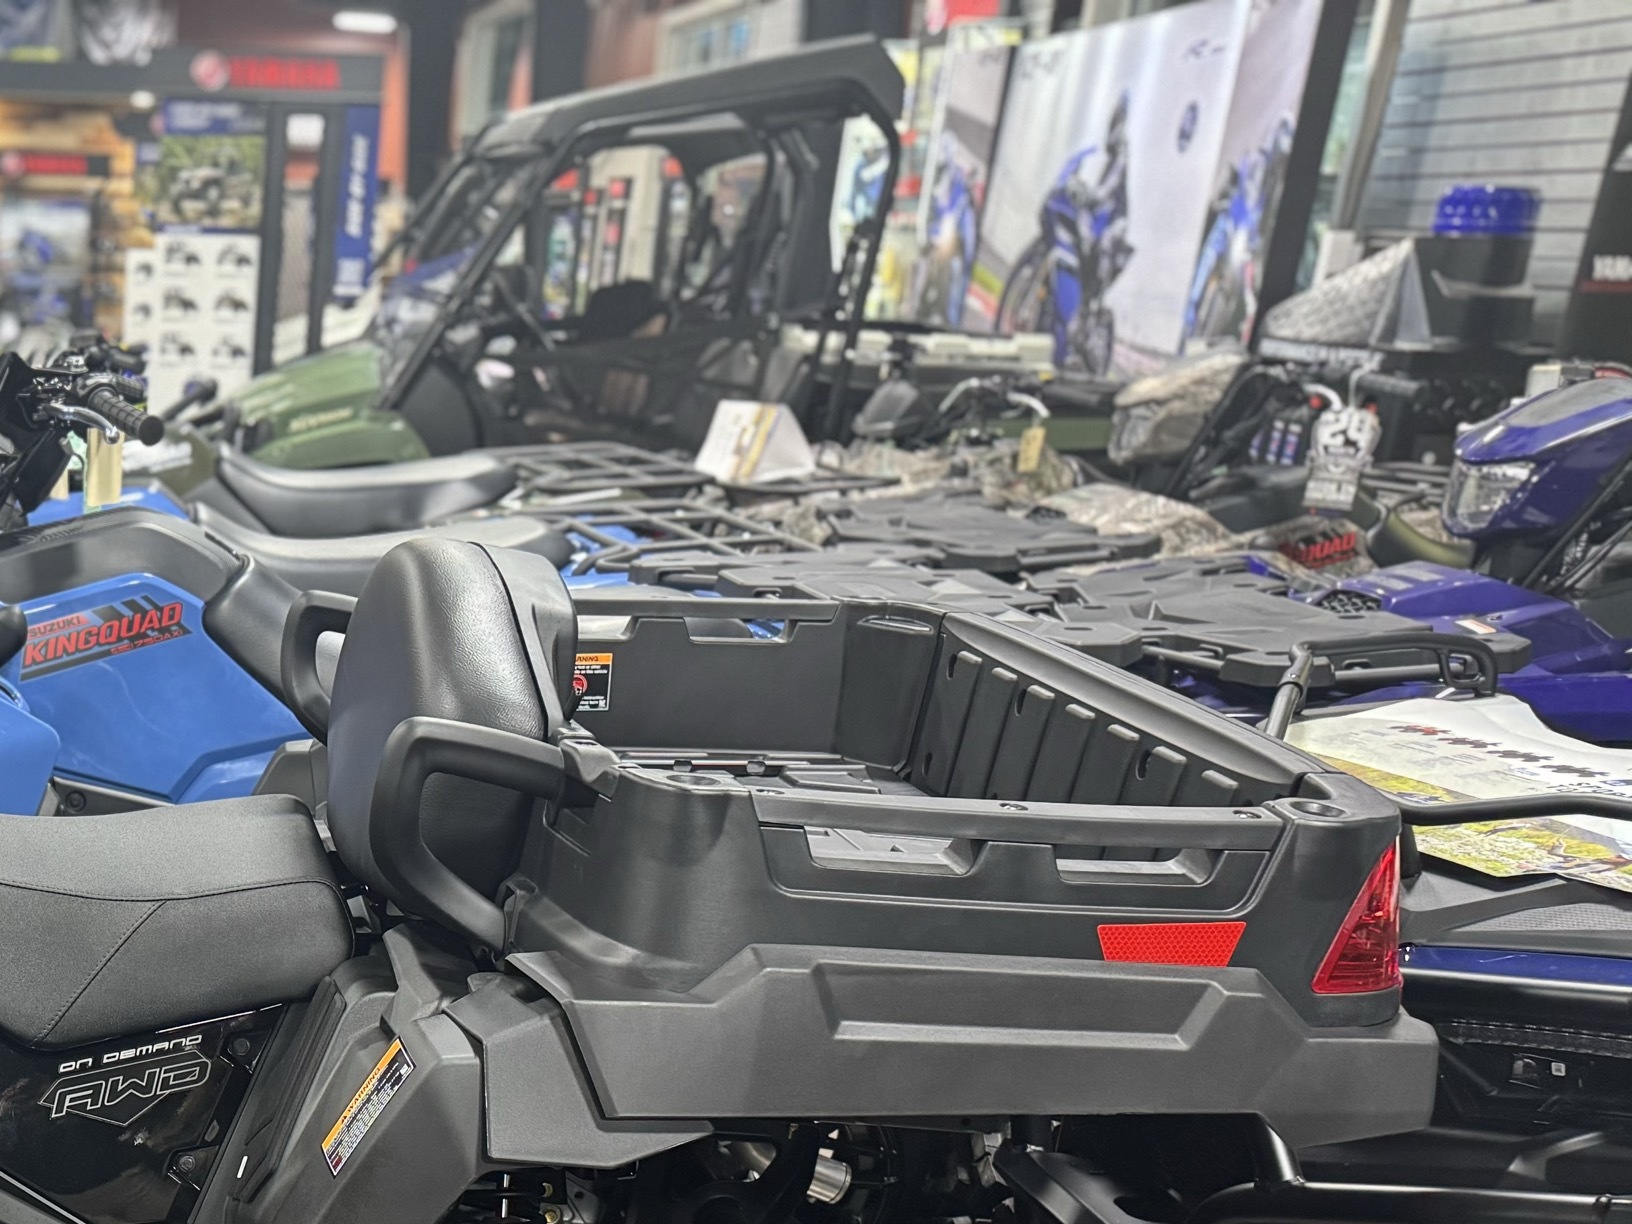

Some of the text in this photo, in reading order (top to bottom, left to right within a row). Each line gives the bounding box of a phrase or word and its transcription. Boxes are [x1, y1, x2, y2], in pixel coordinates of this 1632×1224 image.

[23, 602, 183, 667] KINGQUAD
[27, 616, 81, 638] SUZUKI
[59, 1034, 203, 1074] ON DEMAND
[52, 1058, 212, 1118] AWD
